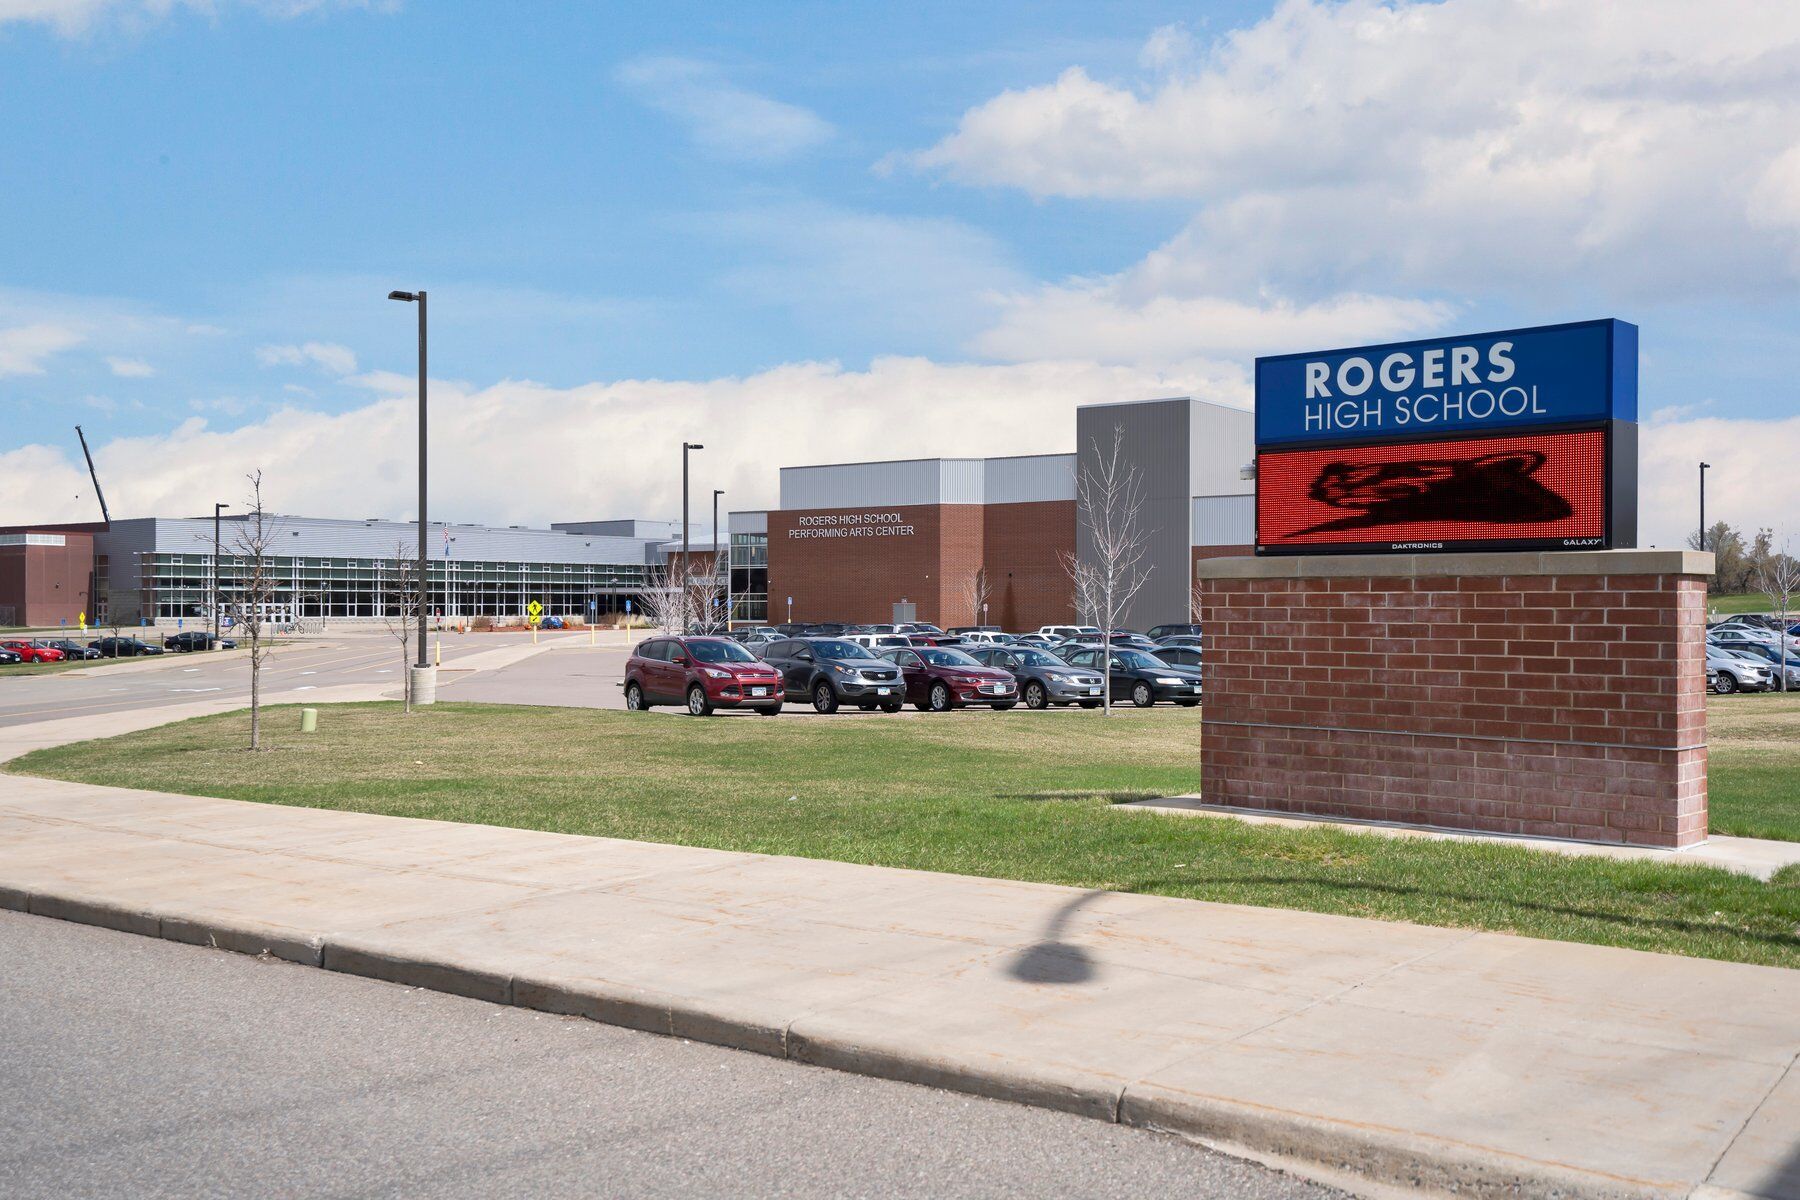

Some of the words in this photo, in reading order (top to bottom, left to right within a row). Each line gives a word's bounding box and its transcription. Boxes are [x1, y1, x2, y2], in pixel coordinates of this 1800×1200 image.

[1305, 341, 1516, 399] ROGERS
[1305, 398, 1382, 432] HIGH
[1394, 385, 1547, 425] SCHOOL
[799, 515, 838, 526] ROGERS
[839, 514, 862, 525] HIGH
[863, 513, 903, 524] SCHOOL
[788, 527, 848, 539] PERFORMING
[849, 526, 874, 537] ARTS
[875, 525, 914, 536] CENTER
[1391, 542, 1443, 550] DAKTRONICS
[1563, 538, 1600, 546] GALAXY
